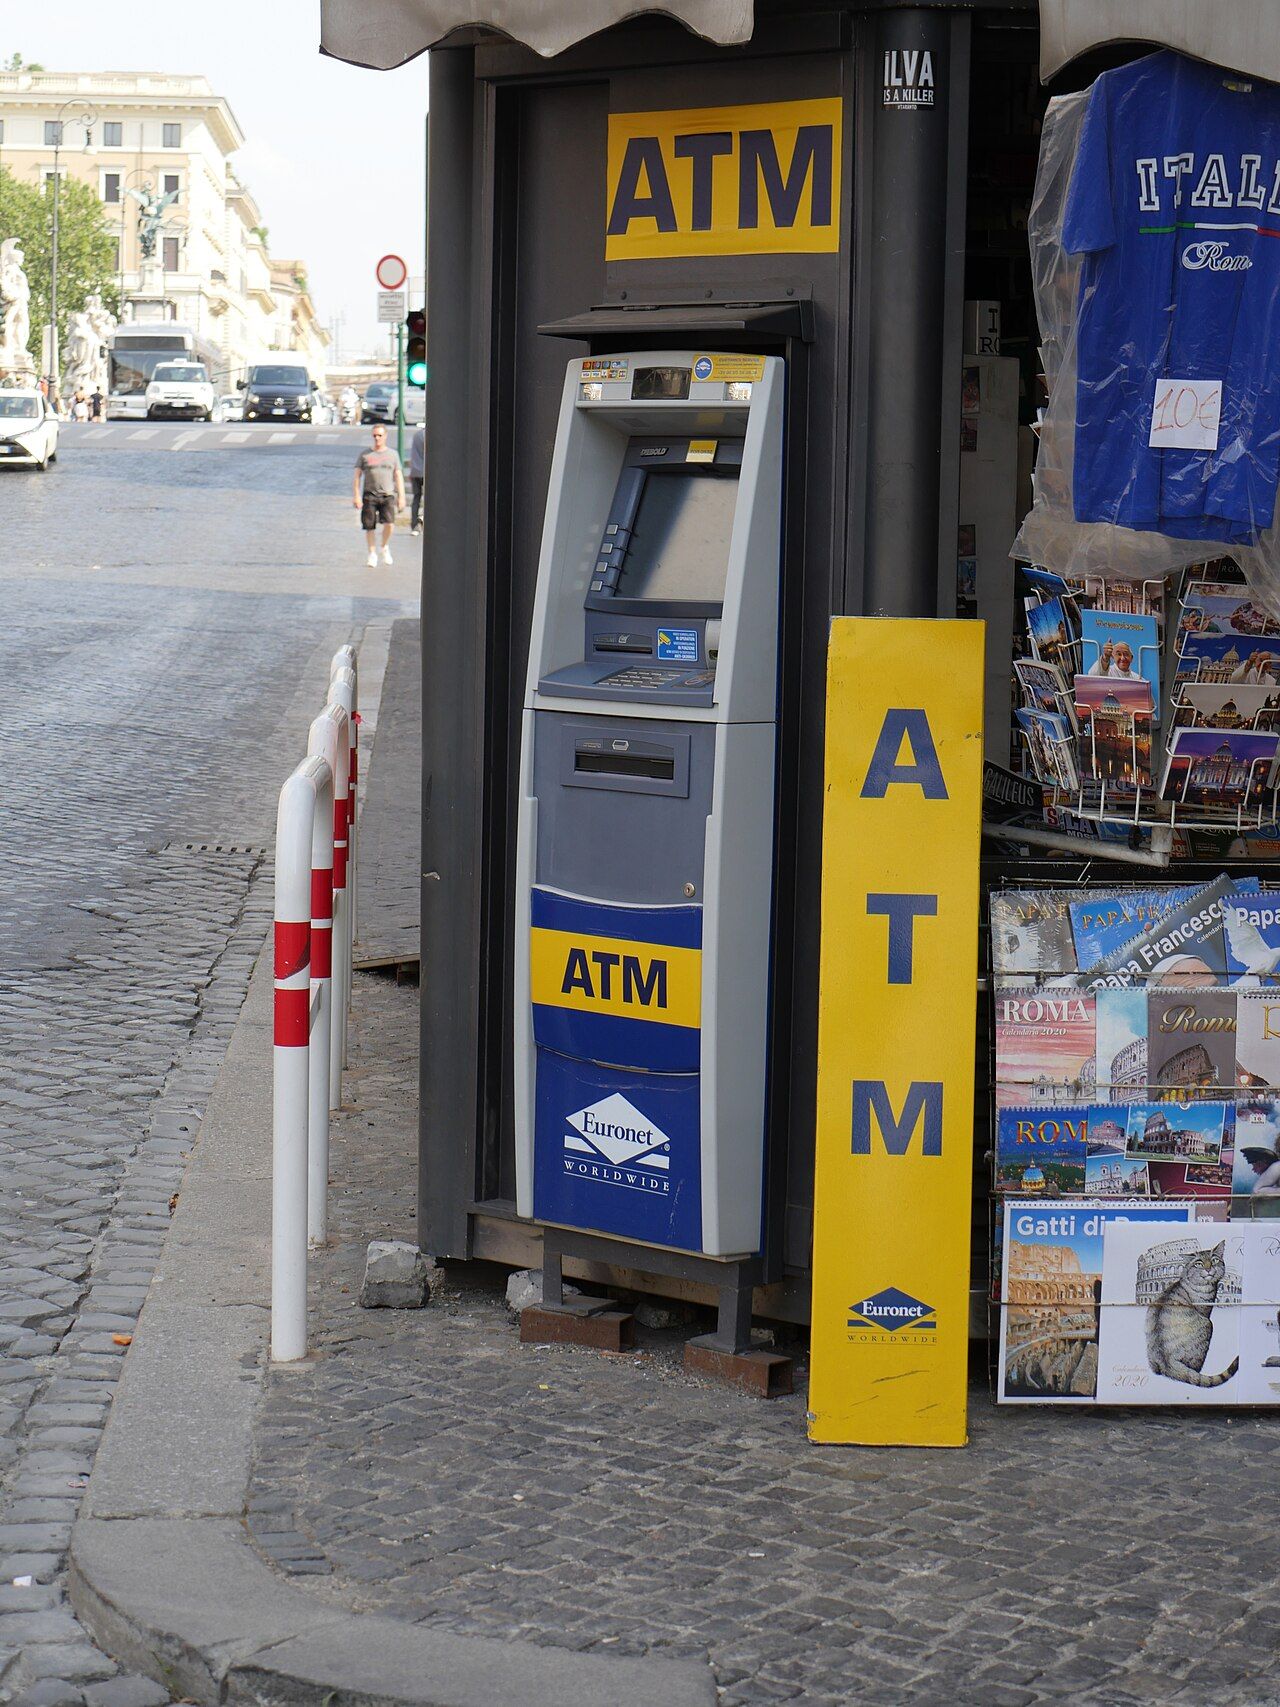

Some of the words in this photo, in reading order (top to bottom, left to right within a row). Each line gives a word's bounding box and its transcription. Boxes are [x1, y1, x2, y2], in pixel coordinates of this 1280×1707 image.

[884, 90, 891, 102] IS
[893, 89, 899, 101] A
[902, 89, 934, 102] KILLER
[607, 125, 833, 235] ATM
[1182, 241, 1253, 271] Rom
[1153, 388, 1218, 431] 10€
[984, 768, 1034, 806] GALILEUS
[1082, 911, 1132, 930] PAPA
[561, 948, 667, 1009] ATM
[1092, 959, 1143, 988] Papa
[1002, 1000, 1090, 1022] ROMA
[1040, 1027, 1067, 1035] 2020
[581, 1111, 654, 1146] Euronet
[1016, 1120, 1087, 1144] ROM
[564, 1160, 670, 1193] WORLDWIDE
[1016, 1215, 1075, 1236] Gatti
[1083, 1215, 1104, 1236] di
[861, 1301, 923, 1317] Euronet
[848, 1335, 937, 1343] WORLDWIDE
[1112, 1375, 1149, 1387] 2020
